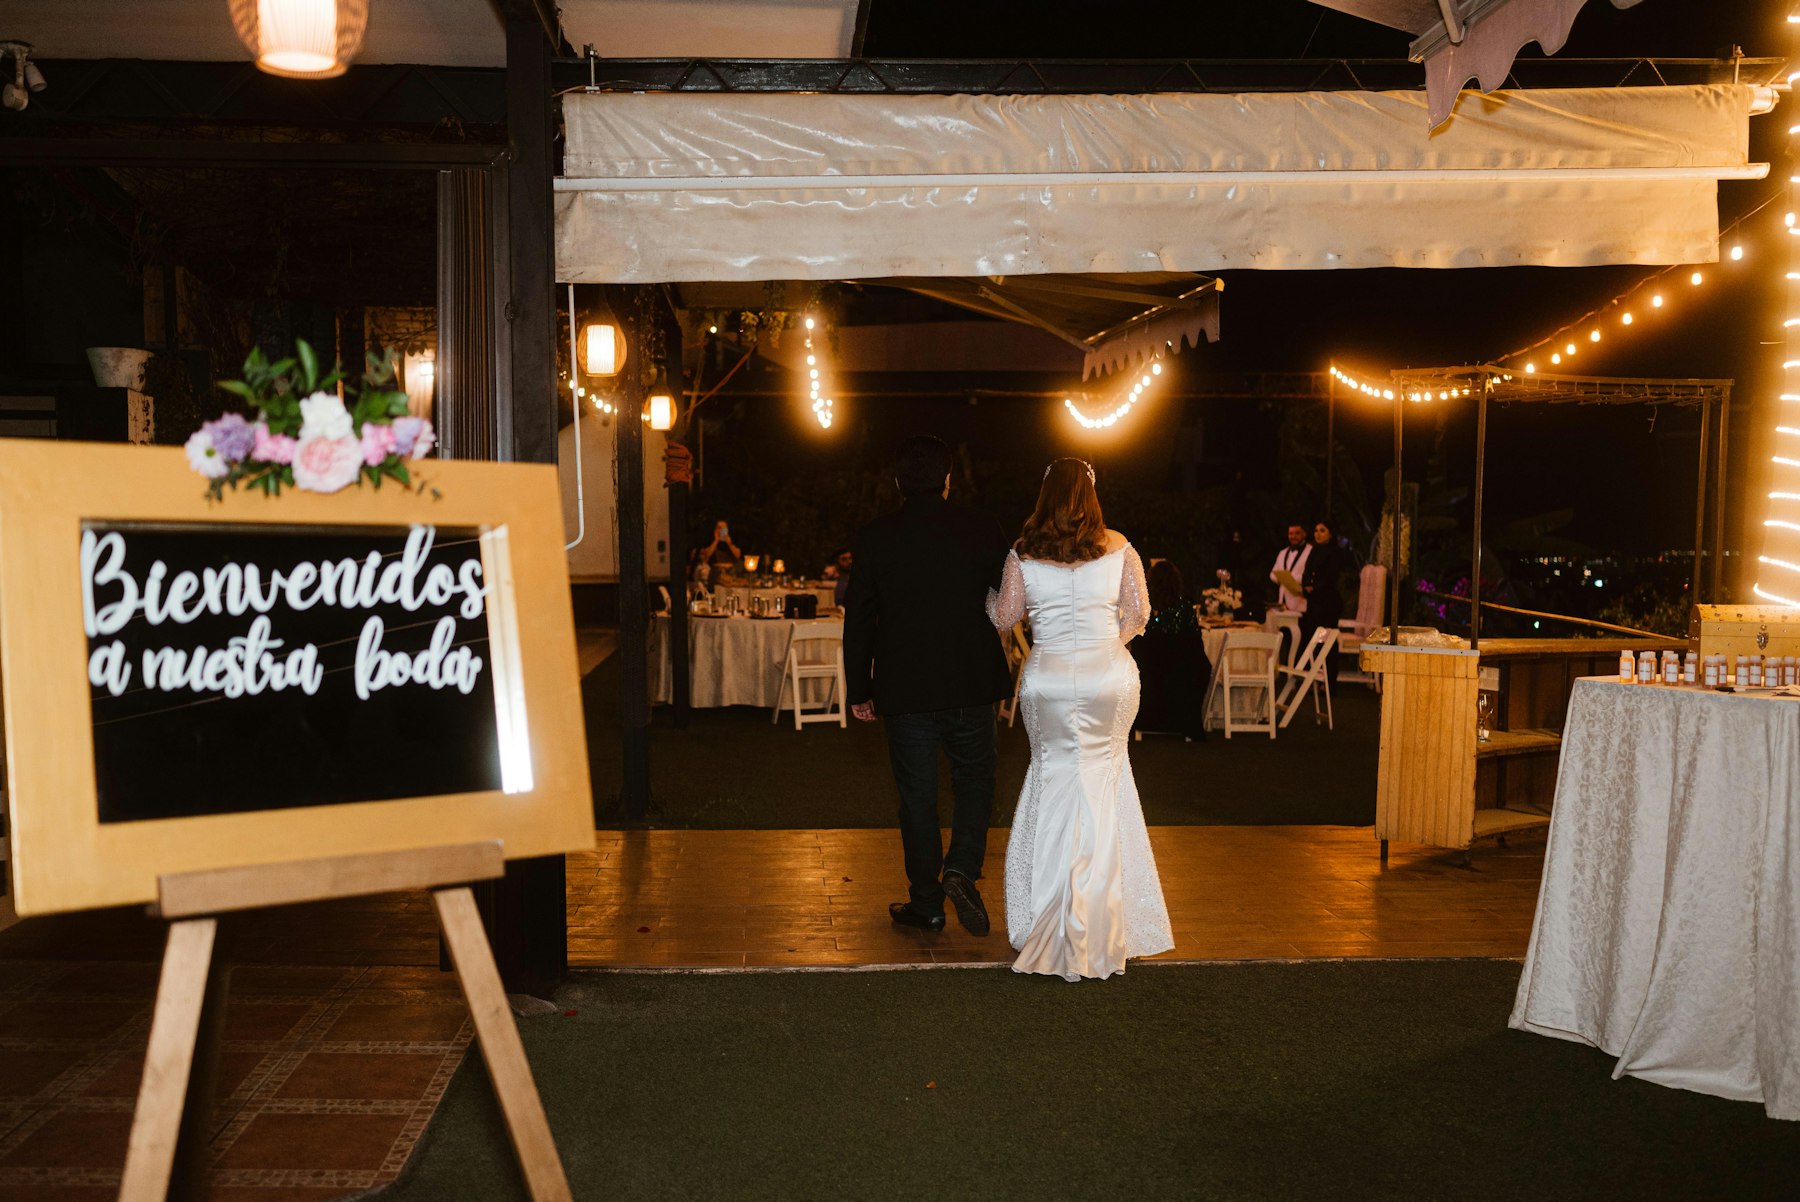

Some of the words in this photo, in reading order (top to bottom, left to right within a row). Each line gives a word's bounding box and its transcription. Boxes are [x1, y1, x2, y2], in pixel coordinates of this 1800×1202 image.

[82, 525, 492, 637] Bienvenidos
[89, 641, 131, 695] a
[142, 616, 324, 698] nuestra
[354, 616, 482, 700] boda
